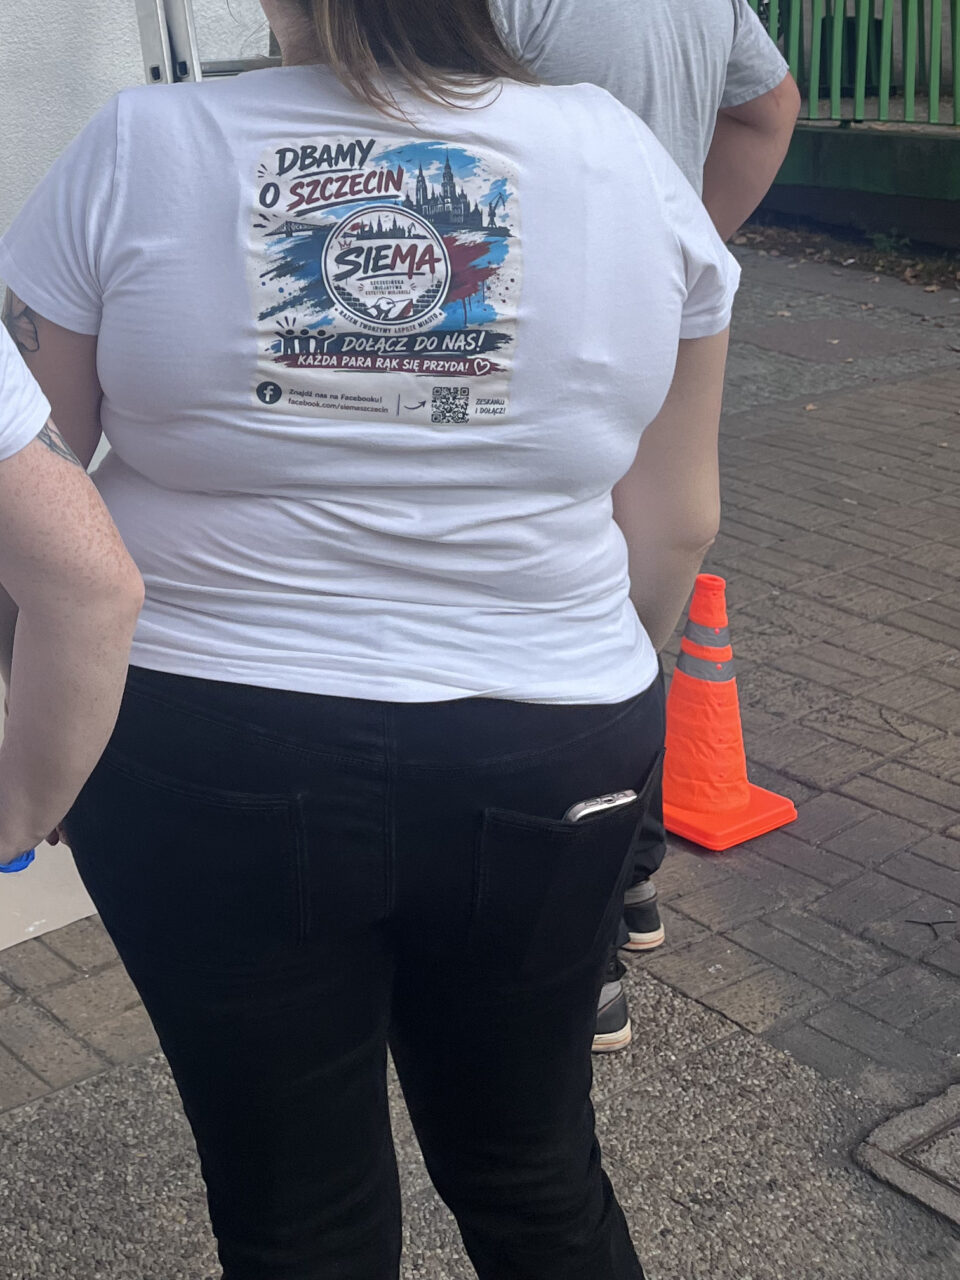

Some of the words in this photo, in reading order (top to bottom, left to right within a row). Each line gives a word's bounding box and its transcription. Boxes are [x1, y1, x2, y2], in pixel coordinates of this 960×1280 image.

[275, 138, 376, 176] DBAMY
[259, 182, 280, 208] O
[332, 243, 442, 282] SIEMA
[341, 336, 407, 356] DOŁĄCZ
[414, 336, 438, 351] DO
[442, 331, 486, 351] NAS!
[298, 354, 338, 366] KAŻDA
[341, 356, 372, 368] PARA
[375, 357, 399, 371] RĄK
[402, 359, 420, 372] SIĘ
[423, 360, 469, 373] PRZYDA!
